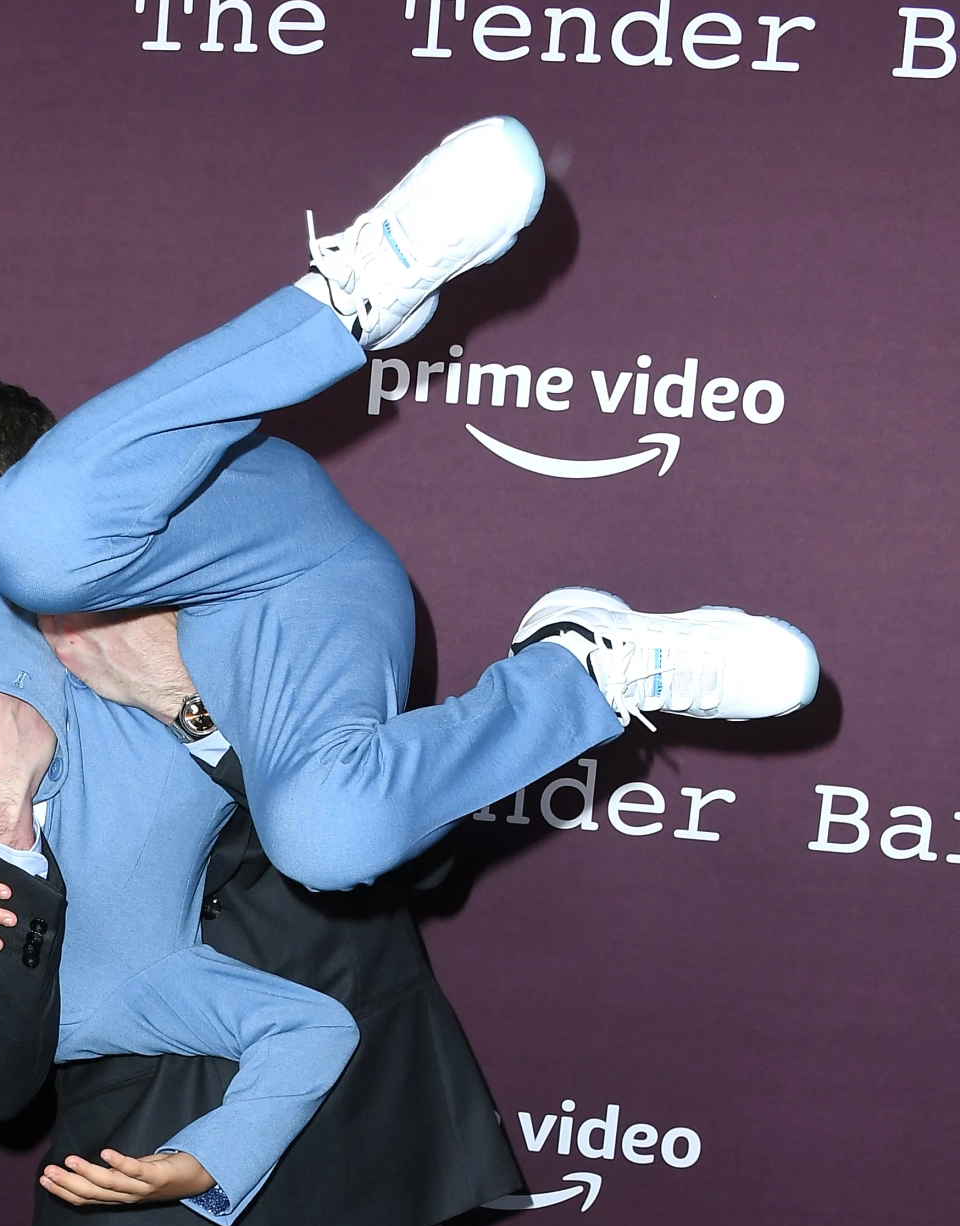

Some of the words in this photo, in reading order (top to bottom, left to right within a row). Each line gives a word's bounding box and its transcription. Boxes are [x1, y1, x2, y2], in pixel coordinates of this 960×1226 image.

[135, 0, 326, 55] The
[404, 0, 816, 72] Tender
[367, 344, 574, 415] prime
[591, 354, 786, 425] video
[807, 784, 960, 864] Ba
[517, 1099, 702, 1168] video
